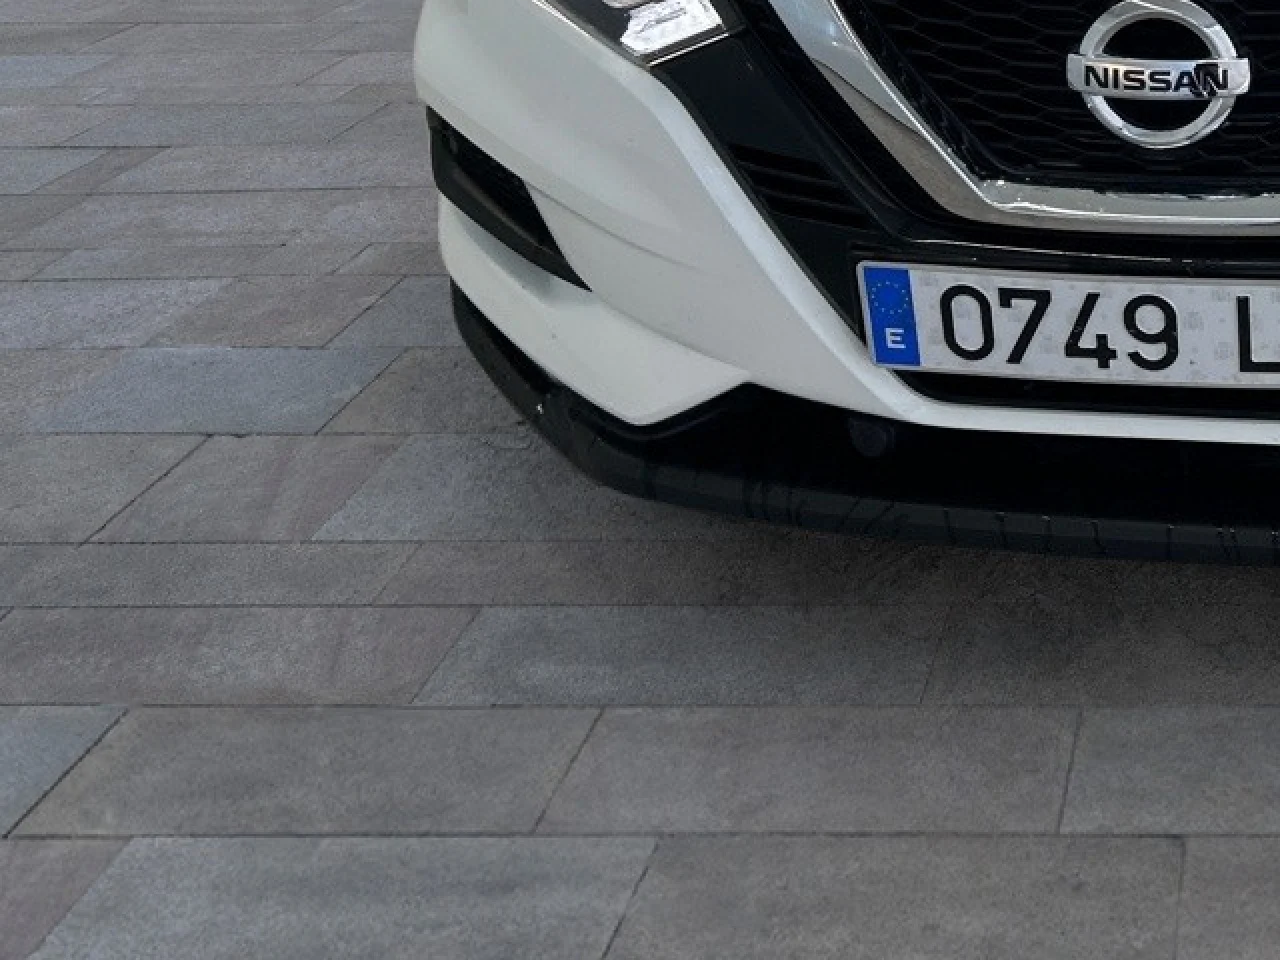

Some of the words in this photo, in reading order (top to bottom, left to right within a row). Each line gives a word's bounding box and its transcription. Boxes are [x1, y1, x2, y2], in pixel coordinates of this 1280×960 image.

[1083, 64, 1230, 95] NISSAN
[885, 327, 907, 349] E
[938, 284, 1179, 371] 0749
